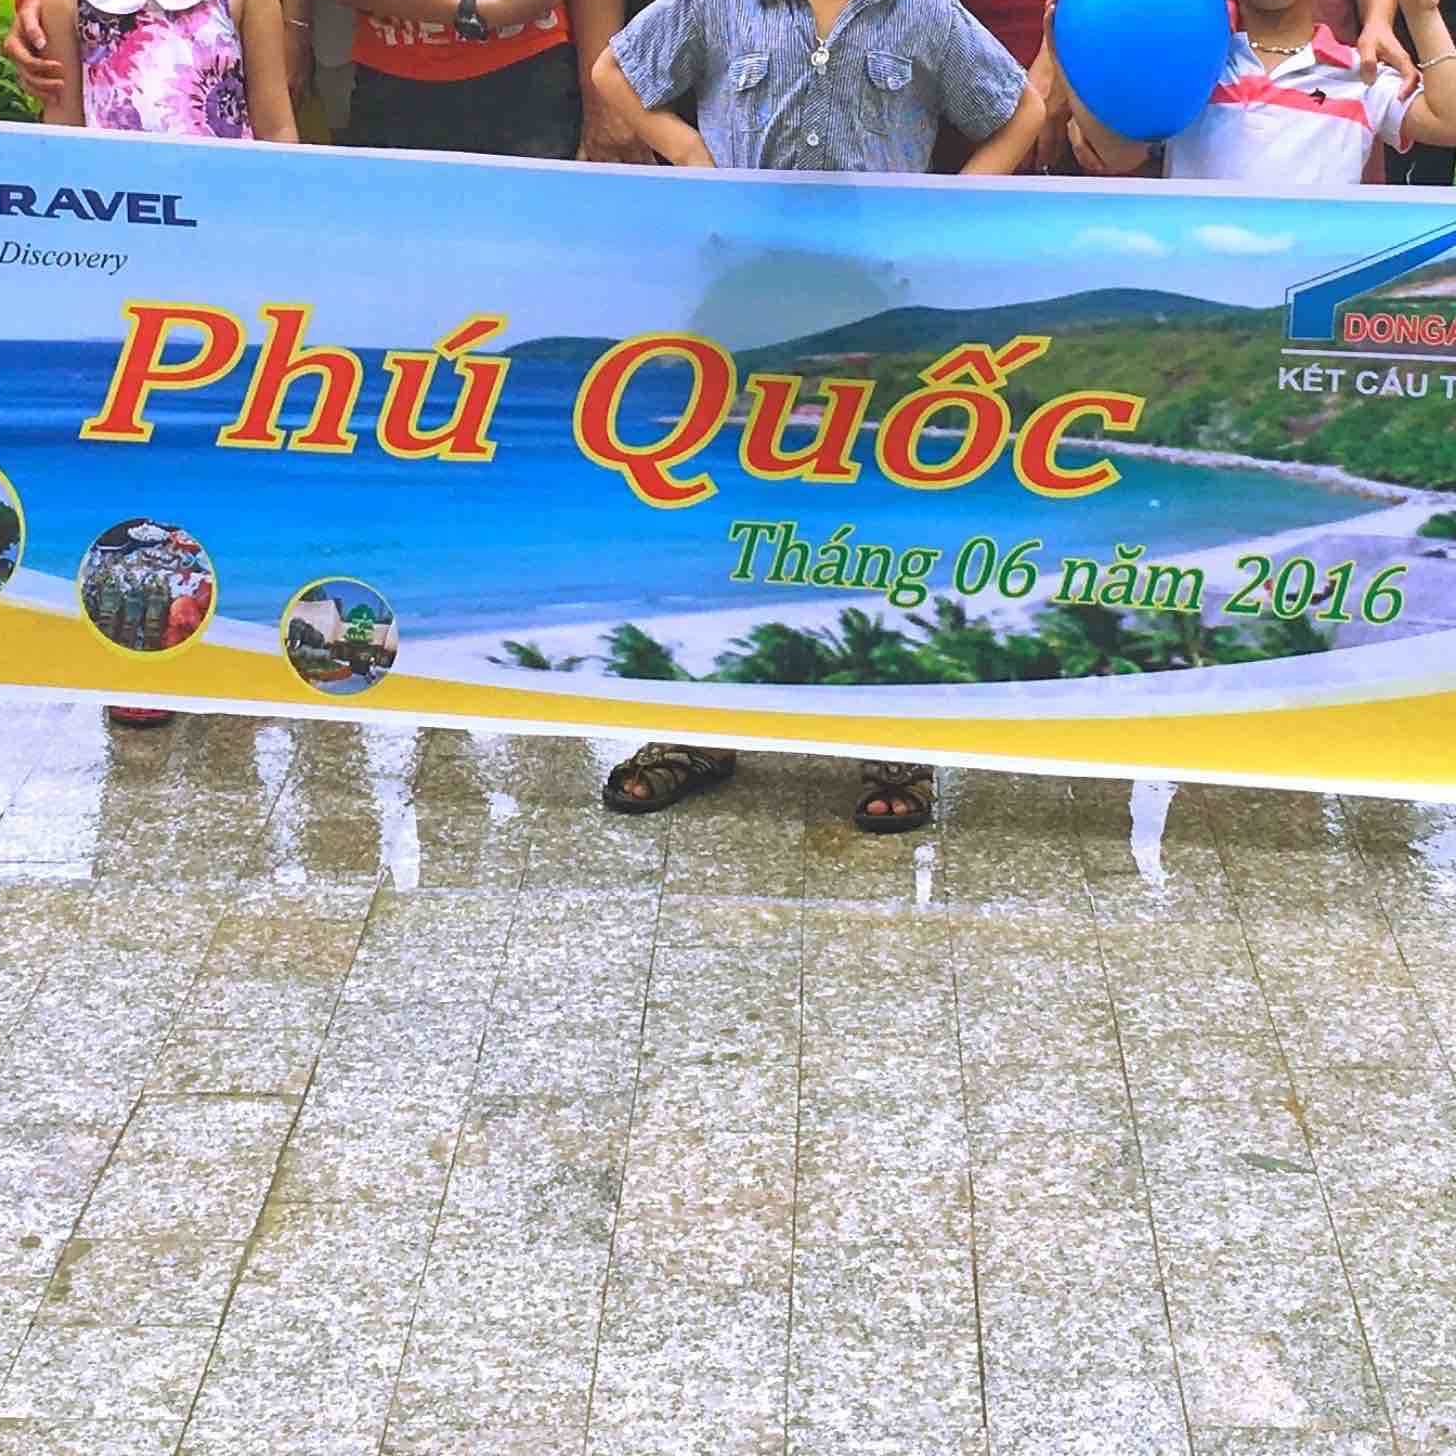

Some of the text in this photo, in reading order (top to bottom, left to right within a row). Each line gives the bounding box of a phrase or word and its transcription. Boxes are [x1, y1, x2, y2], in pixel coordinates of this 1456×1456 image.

[79, 300, 1146, 510] Phú Quốc
[729, 520, 1408, 624] Tháng 06 năm 2016
